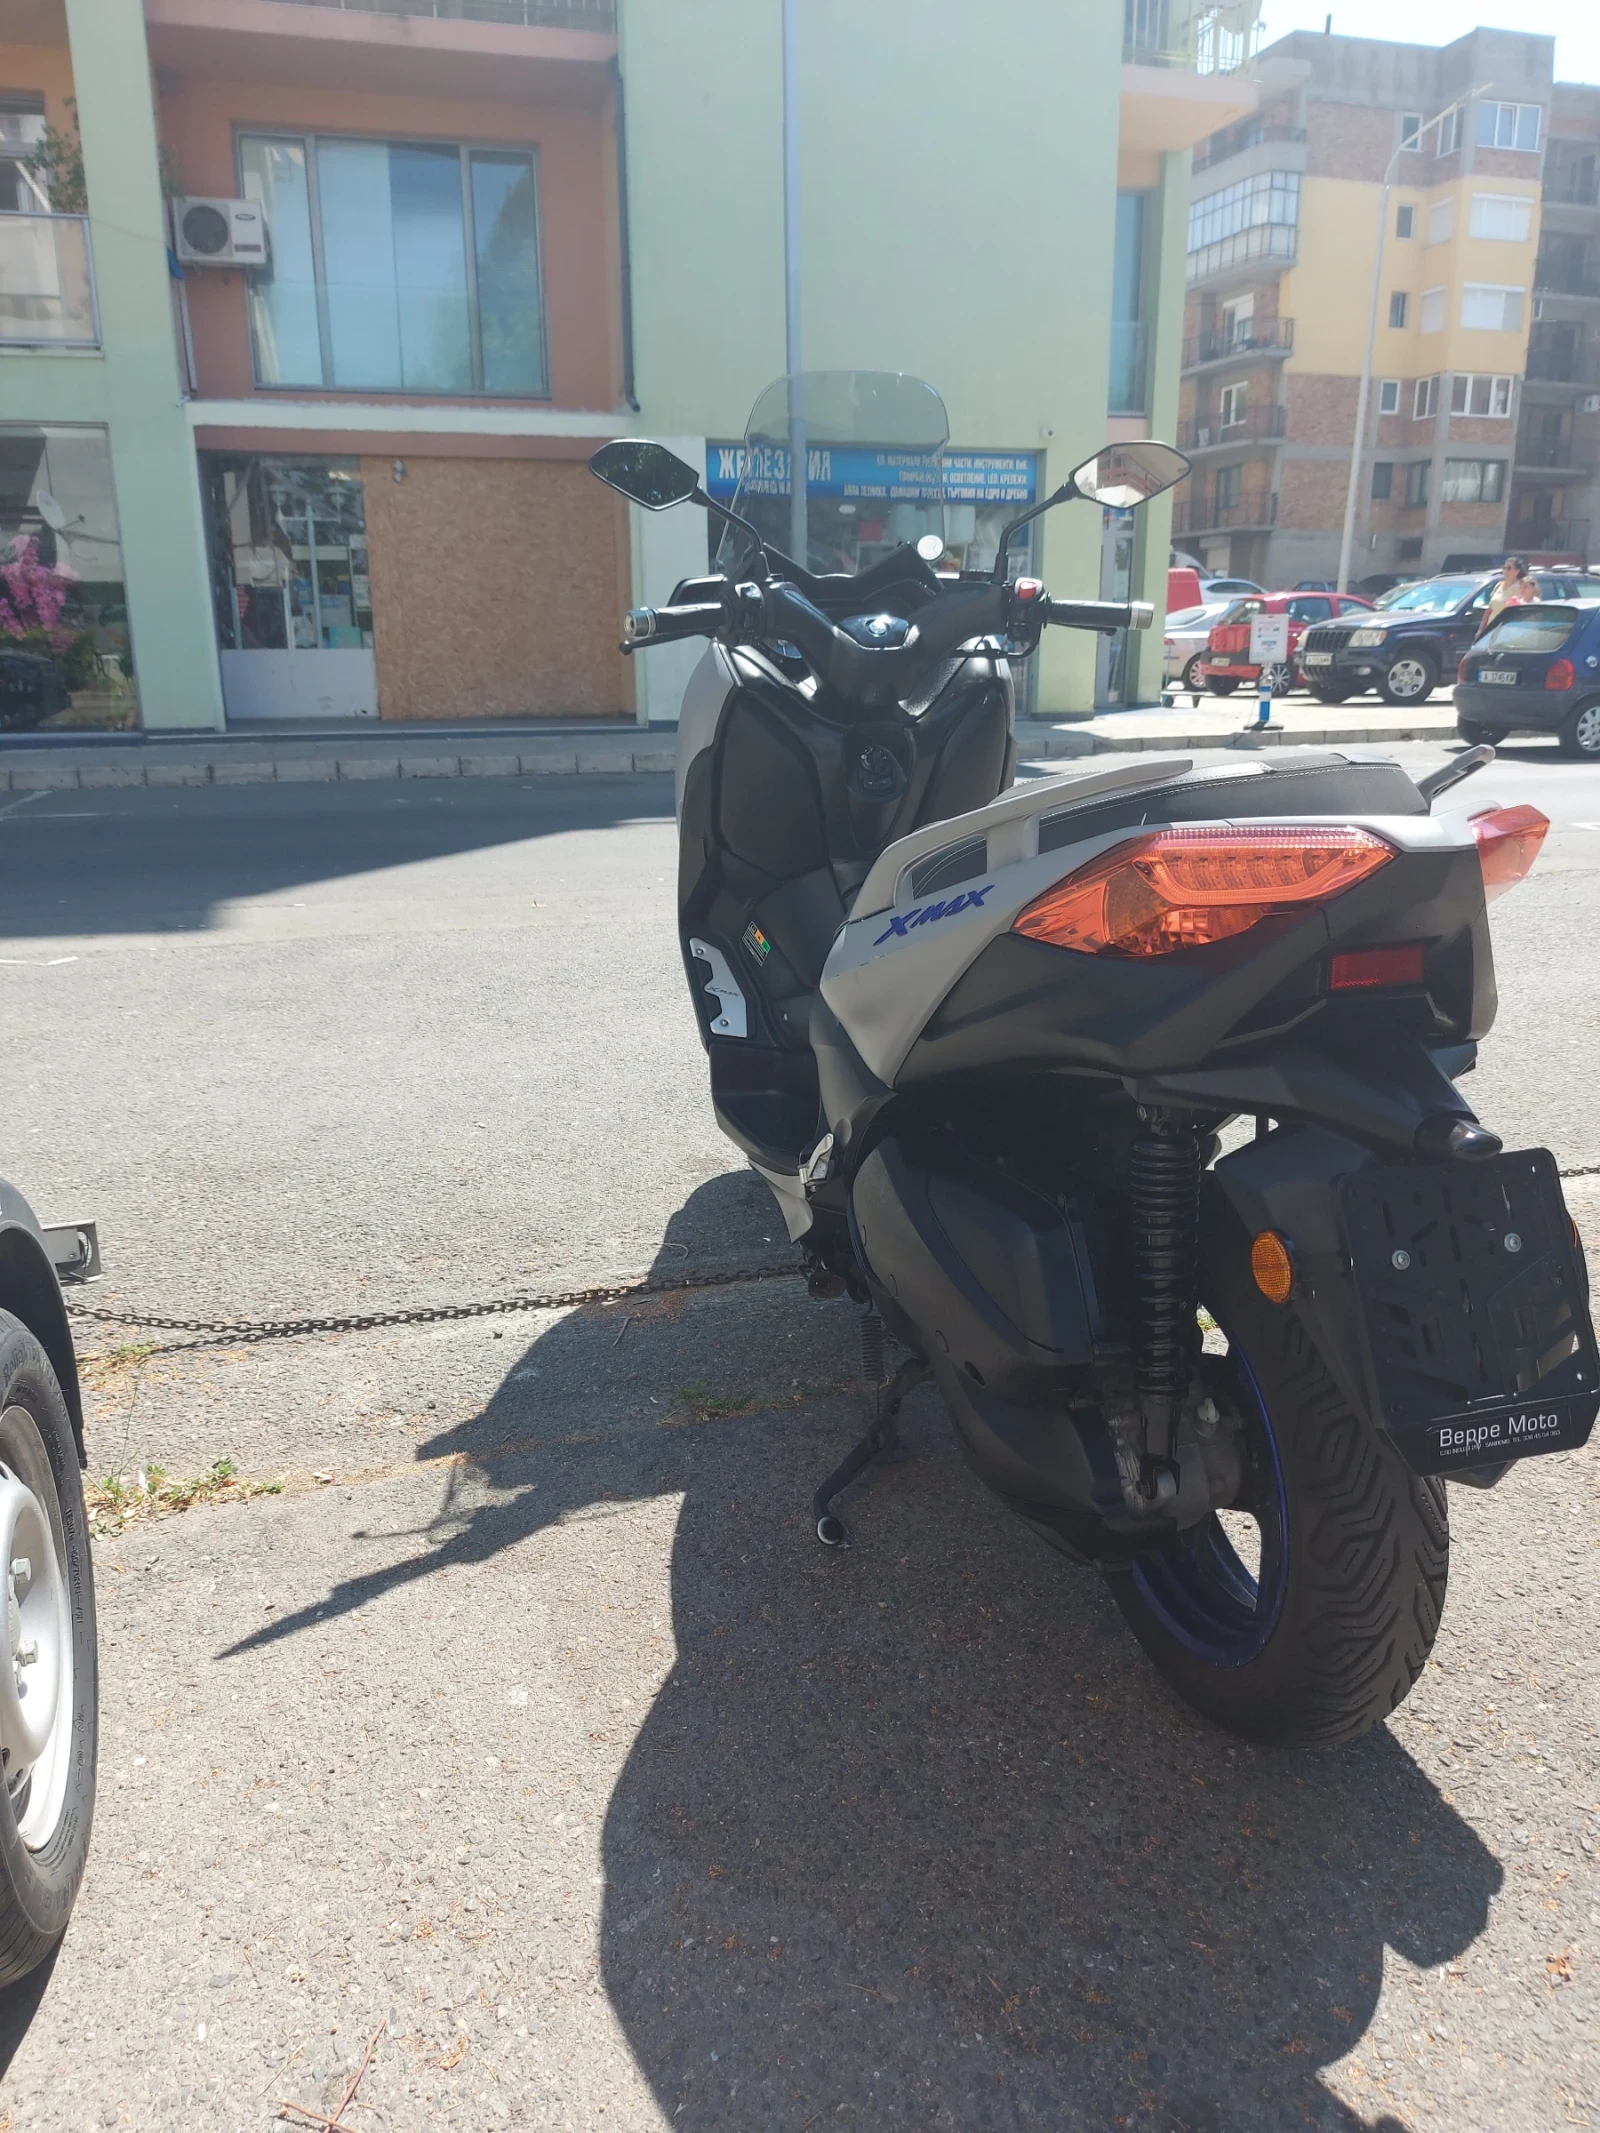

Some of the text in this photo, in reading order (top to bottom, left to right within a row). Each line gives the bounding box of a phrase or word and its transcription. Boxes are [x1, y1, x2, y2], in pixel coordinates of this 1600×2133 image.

[719, 448, 831, 481] ЖЕЛЕЗИЯ
[873, 885, 995, 946] XMAX
[1440, 1413, 1557, 1448] Beppe Moto
